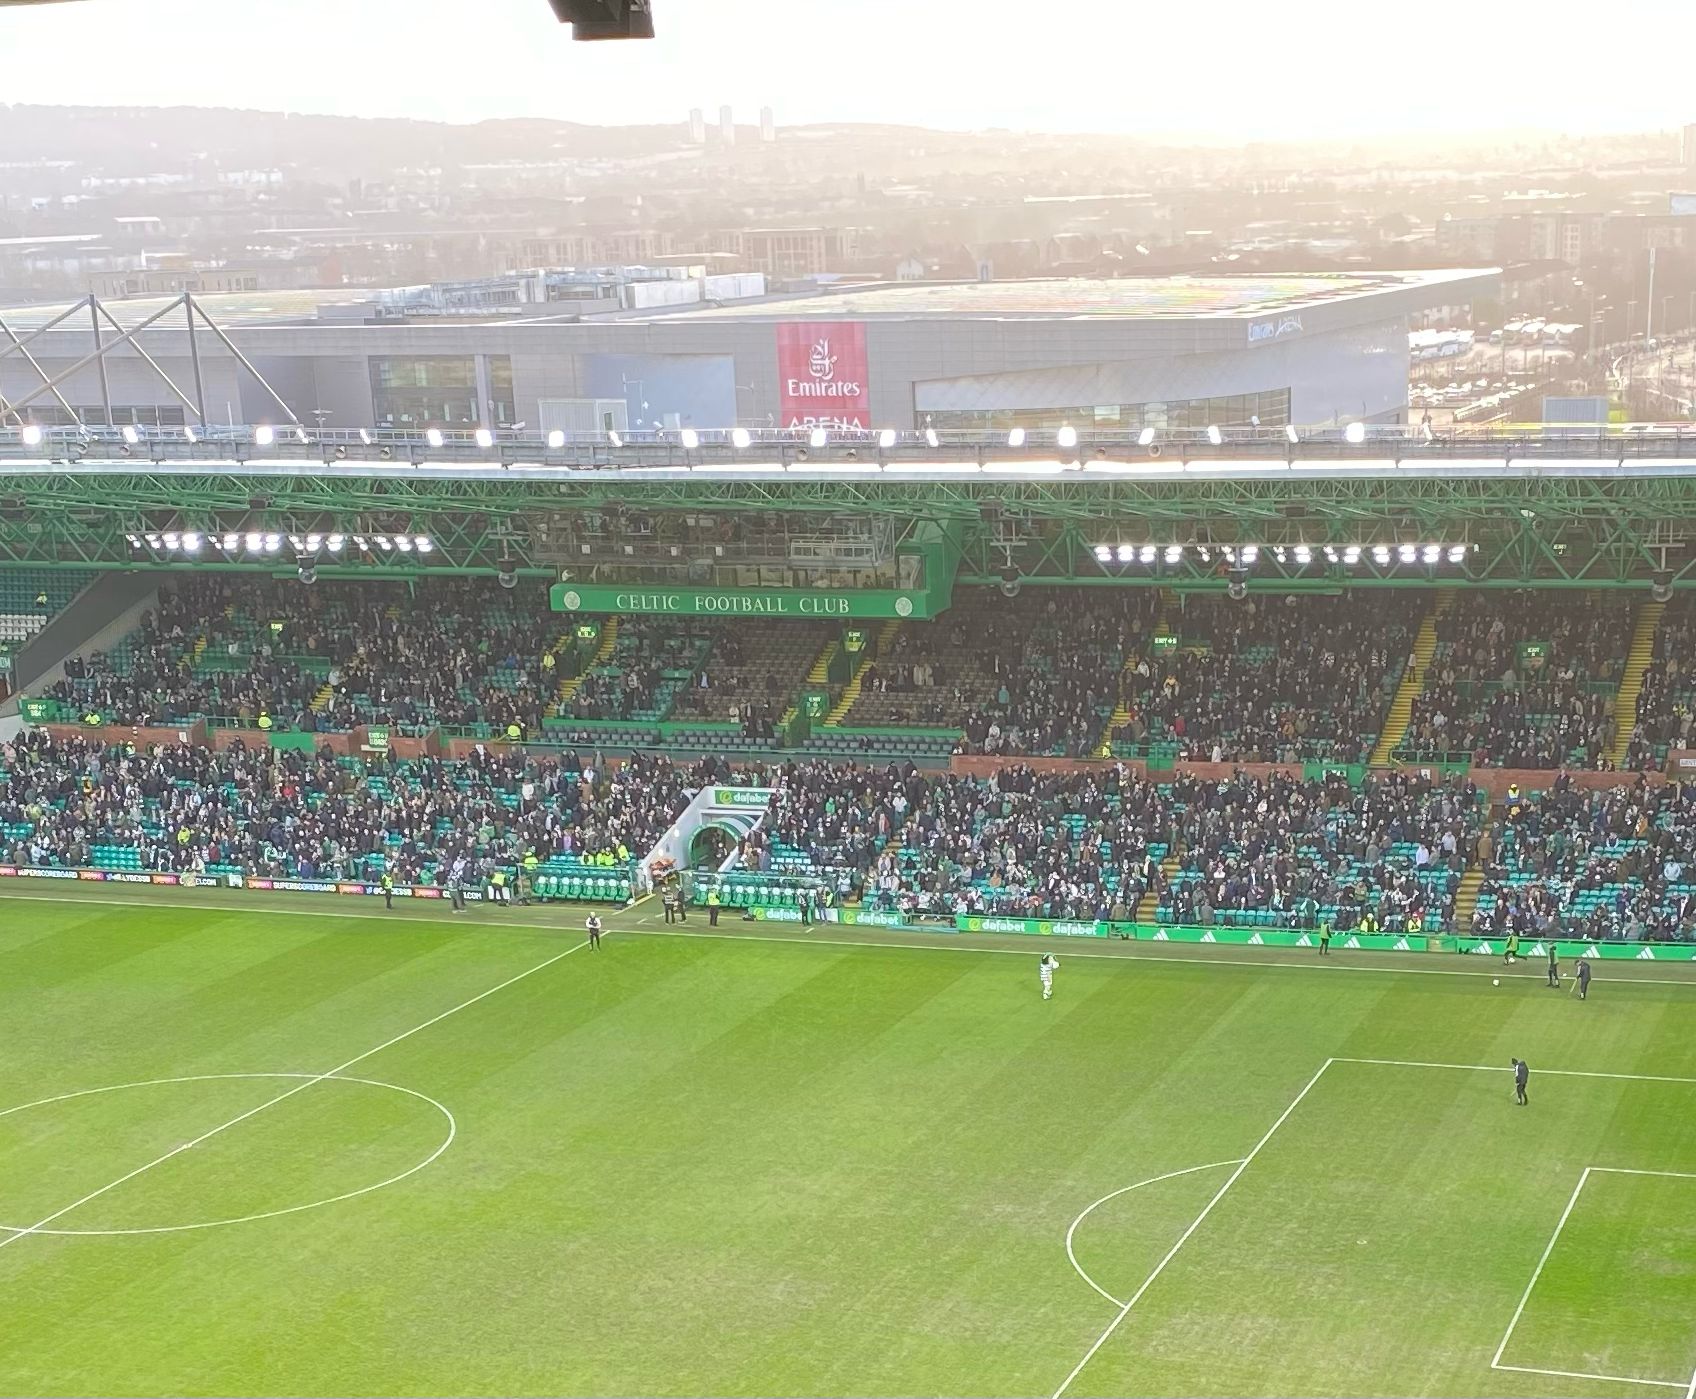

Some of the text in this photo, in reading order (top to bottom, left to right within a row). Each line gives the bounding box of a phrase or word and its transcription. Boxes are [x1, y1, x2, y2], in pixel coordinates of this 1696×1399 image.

[788, 379, 860, 397] Emirates
[616, 594, 850, 614] CELTIC FOOTBALL CLUB
[733, 791, 769, 805] dafabe
[766, 908, 803, 923] dafabe
[857, 913, 899, 926] dafabet
[982, 918, 1098, 937] dafabet dafabet
